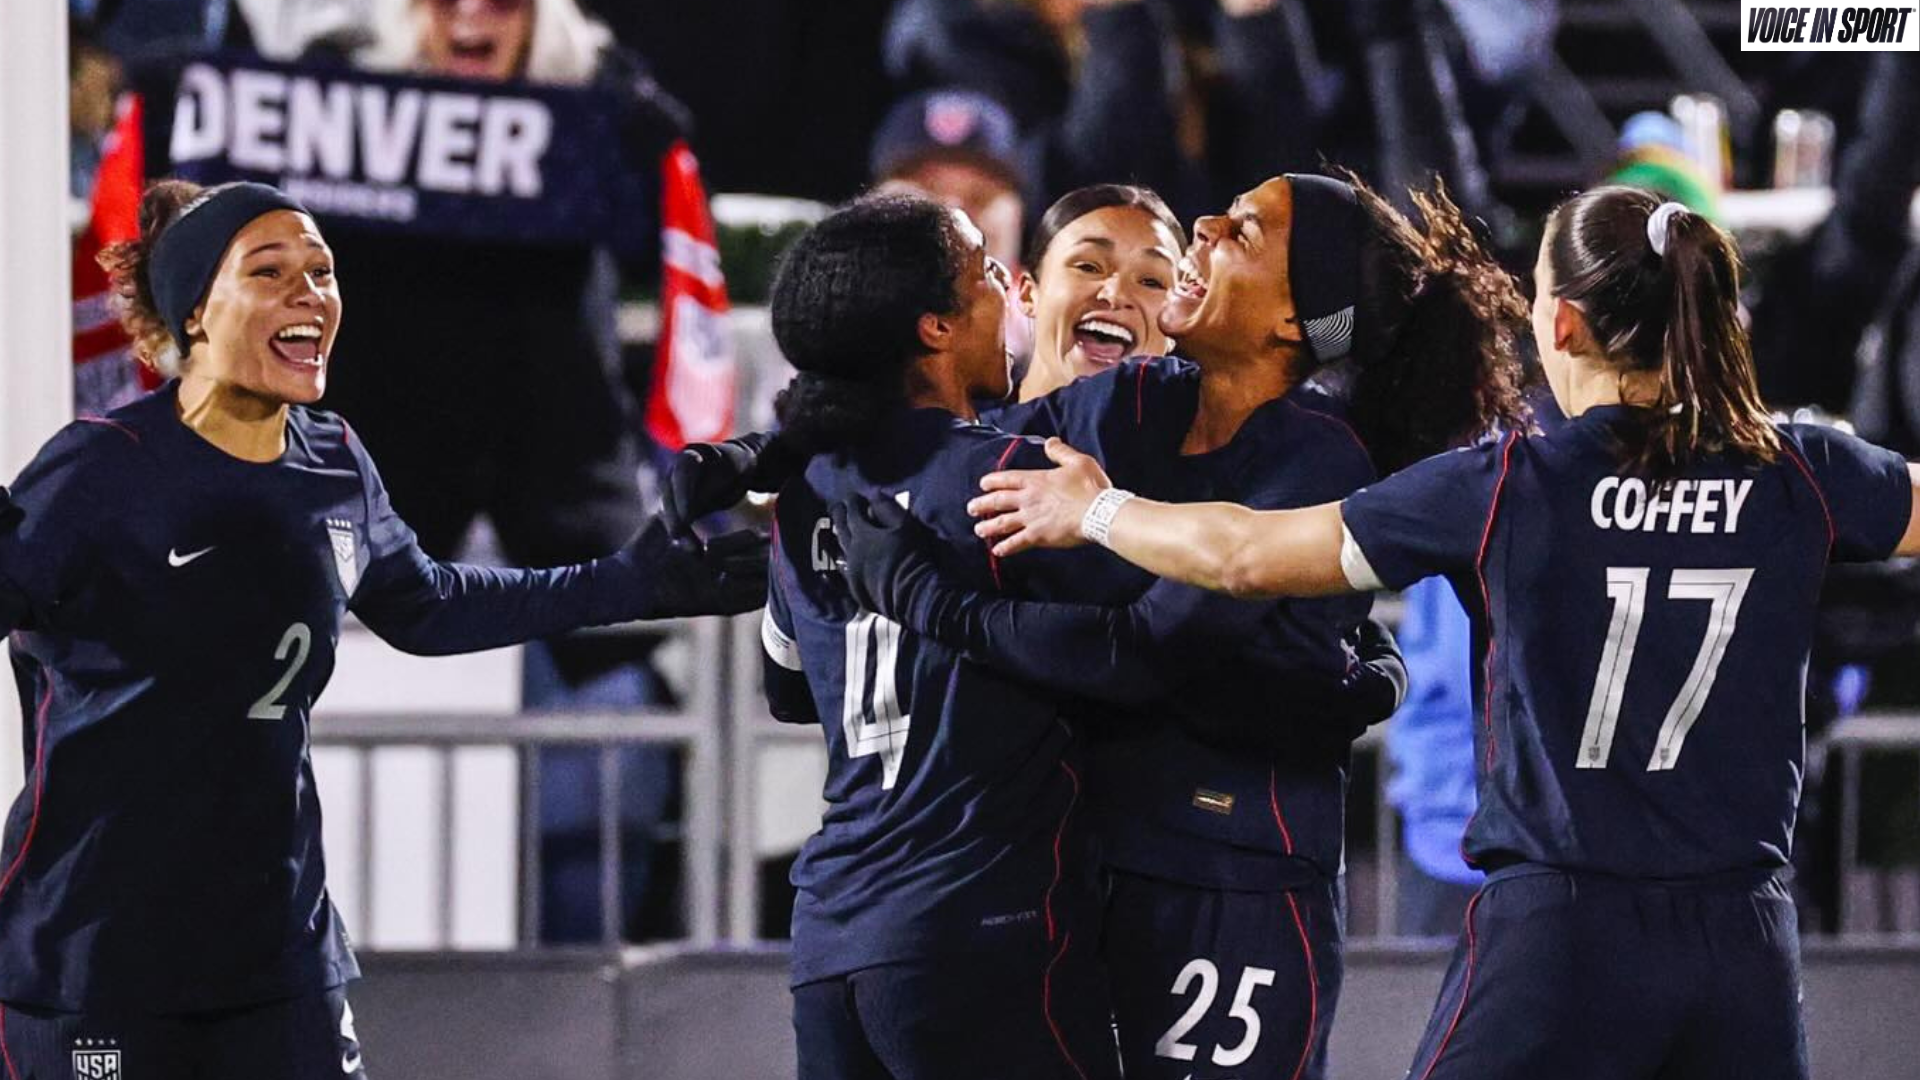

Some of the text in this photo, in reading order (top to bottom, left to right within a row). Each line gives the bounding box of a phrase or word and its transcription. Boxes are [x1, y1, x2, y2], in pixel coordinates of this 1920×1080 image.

[170, 64, 552, 198] DENVER
[1590, 476, 1754, 534] COFFEY
[247, 622, 311, 719] 2
[842, 612, 911, 790] 4
[1575, 566, 1756, 772] 17
[76, 1054, 117, 1079] USA
[1154, 958, 1276, 1067] 25
